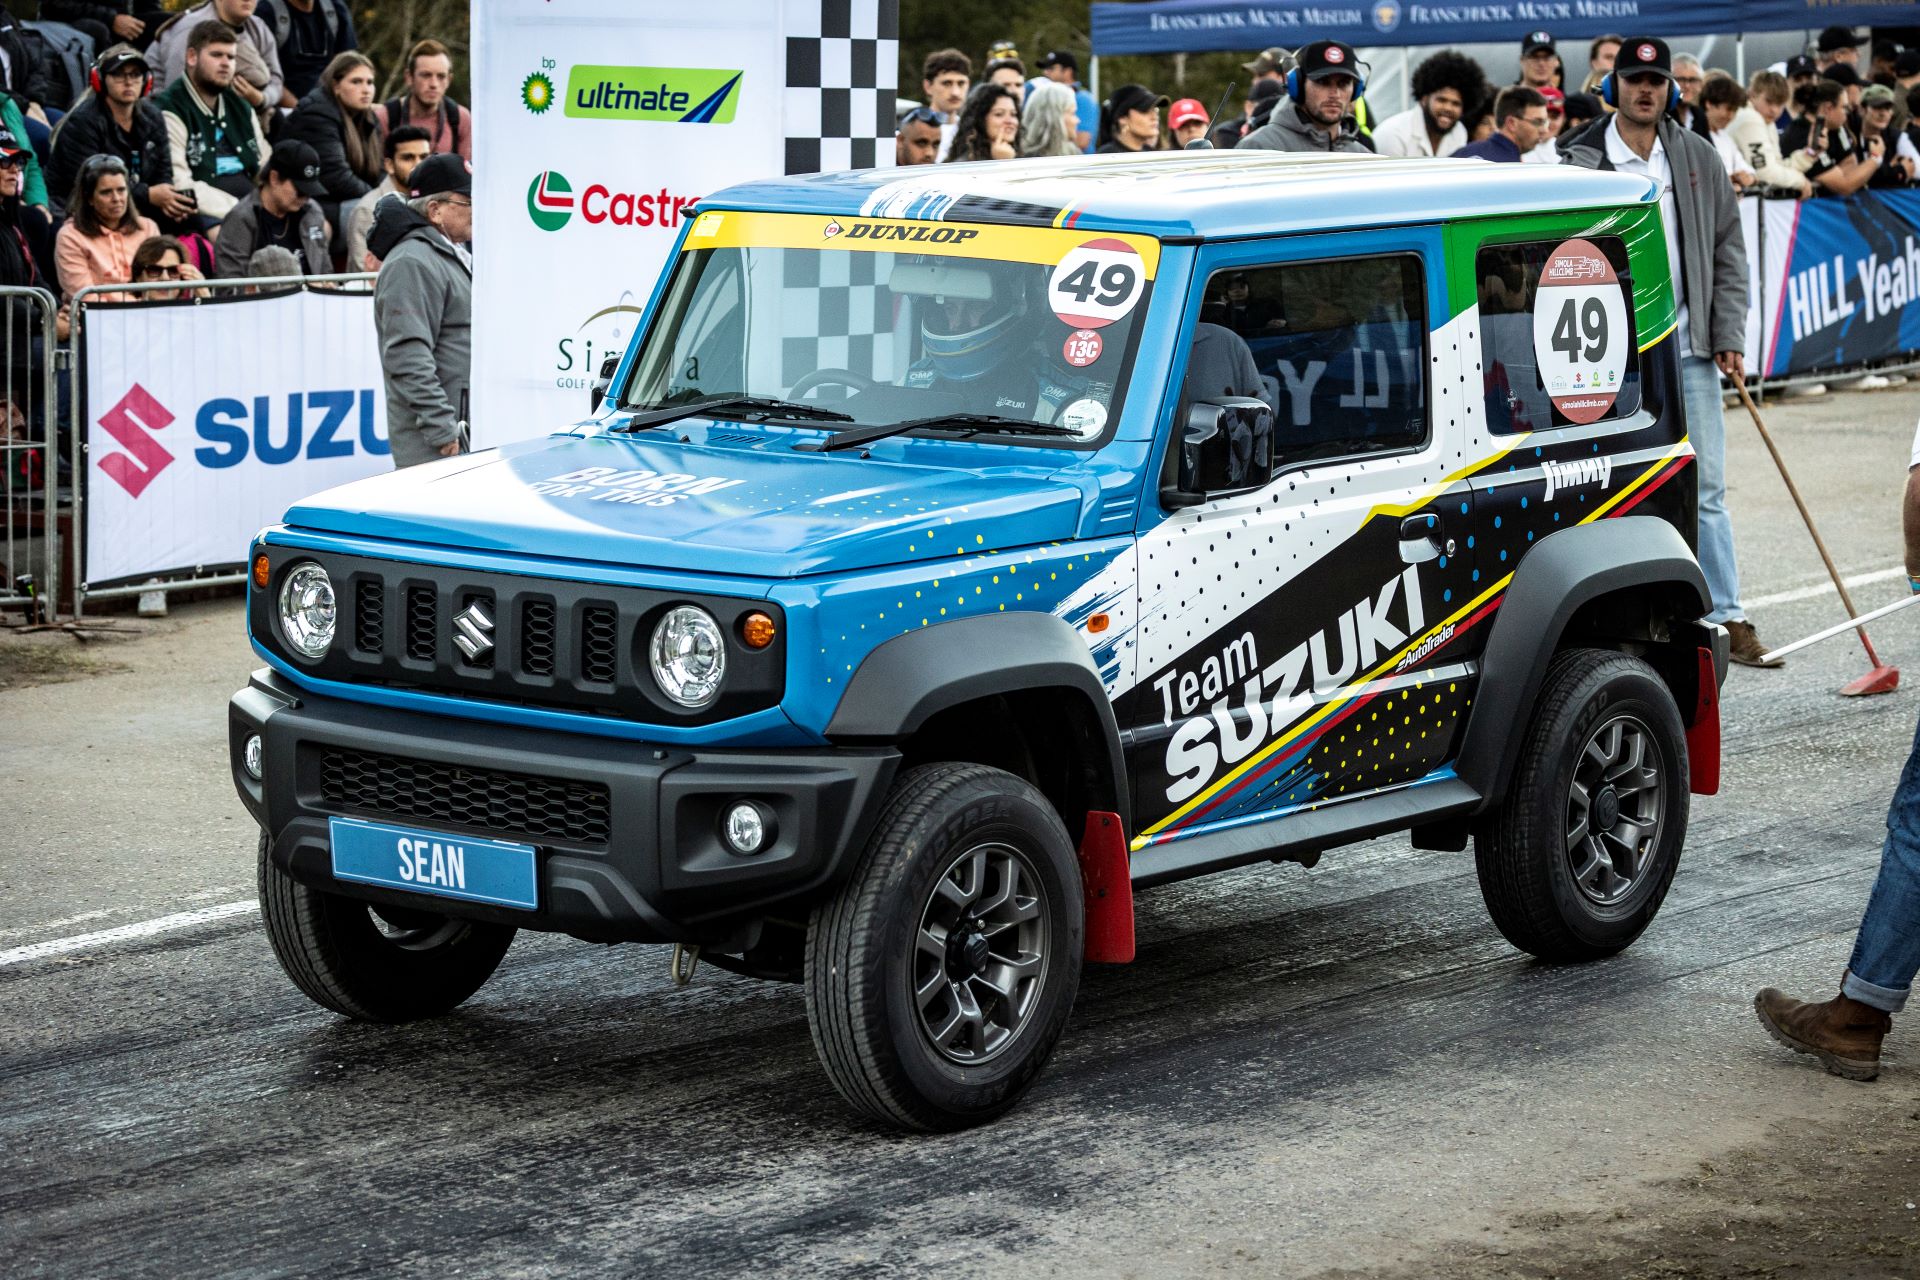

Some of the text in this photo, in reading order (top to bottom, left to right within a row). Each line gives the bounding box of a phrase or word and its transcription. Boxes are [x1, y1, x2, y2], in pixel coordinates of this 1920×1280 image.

[541, 57, 556, 71] bp
[577, 82, 690, 112] ultimate
[581, 184, 702, 229] Castr
[844, 223, 979, 244] DUNLOP
[1057, 260, 1136, 307] 49
[1788, 254, 1855, 343] HILL
[1551, 296, 1609, 363] 49
[1069, 340, 1099, 358] 13C
[556, 377, 586, 390] GOLF
[909, 371, 933, 380] OMP
[1044, 386, 1067, 398] OMP
[1561, 399, 1609, 410] simolahillclimb.com
[527, 481, 689, 507] FOR THIS
[544, 466, 748, 496] BORN
[1404, 624, 1456, 669] AutoTrader
[1153, 631, 1258, 728] Team
[1165, 562, 1425, 803] SUZUKI
[397, 837, 466, 889] SEAN
